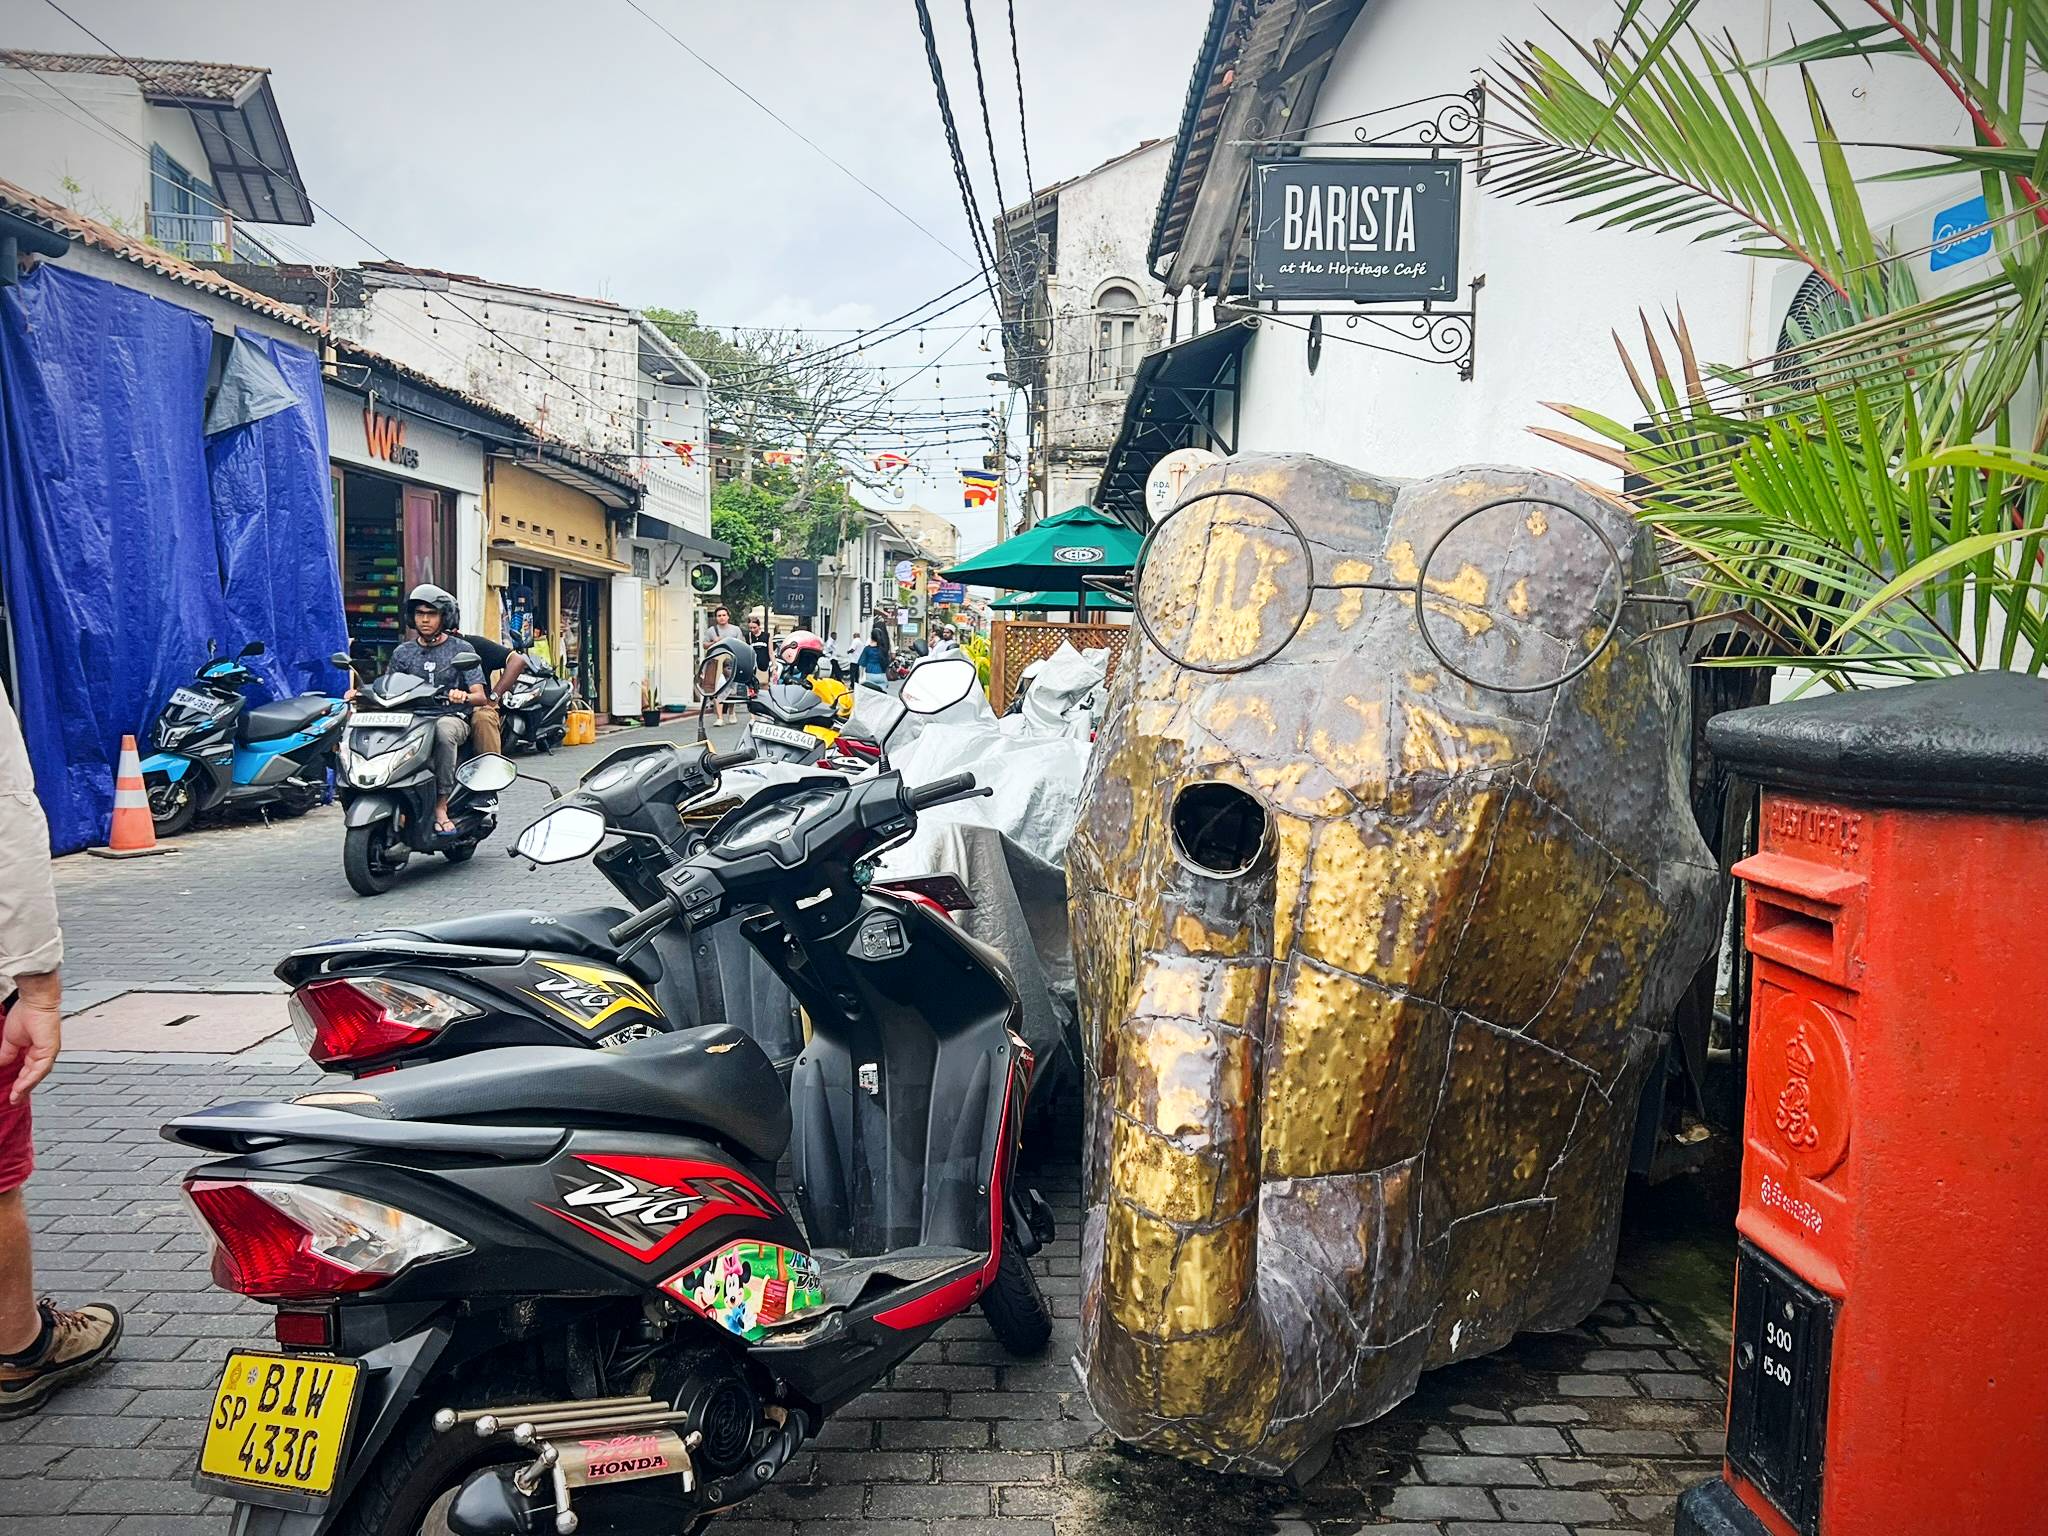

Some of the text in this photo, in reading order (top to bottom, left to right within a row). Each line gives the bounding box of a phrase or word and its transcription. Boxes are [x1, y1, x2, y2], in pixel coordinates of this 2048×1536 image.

[1283, 184, 1416, 252] BARISTA
[1279, 261, 1427, 279] at the Heritage Café
[788, 593, 804, 601] 1710
[563, 1164, 704, 1225] Dio
[215, 1394, 247, 1431] SP
[257, 1363, 334, 1420] BIW
[238, 1422, 318, 1481] 4330
[589, 1455, 665, 1476] HONDA
